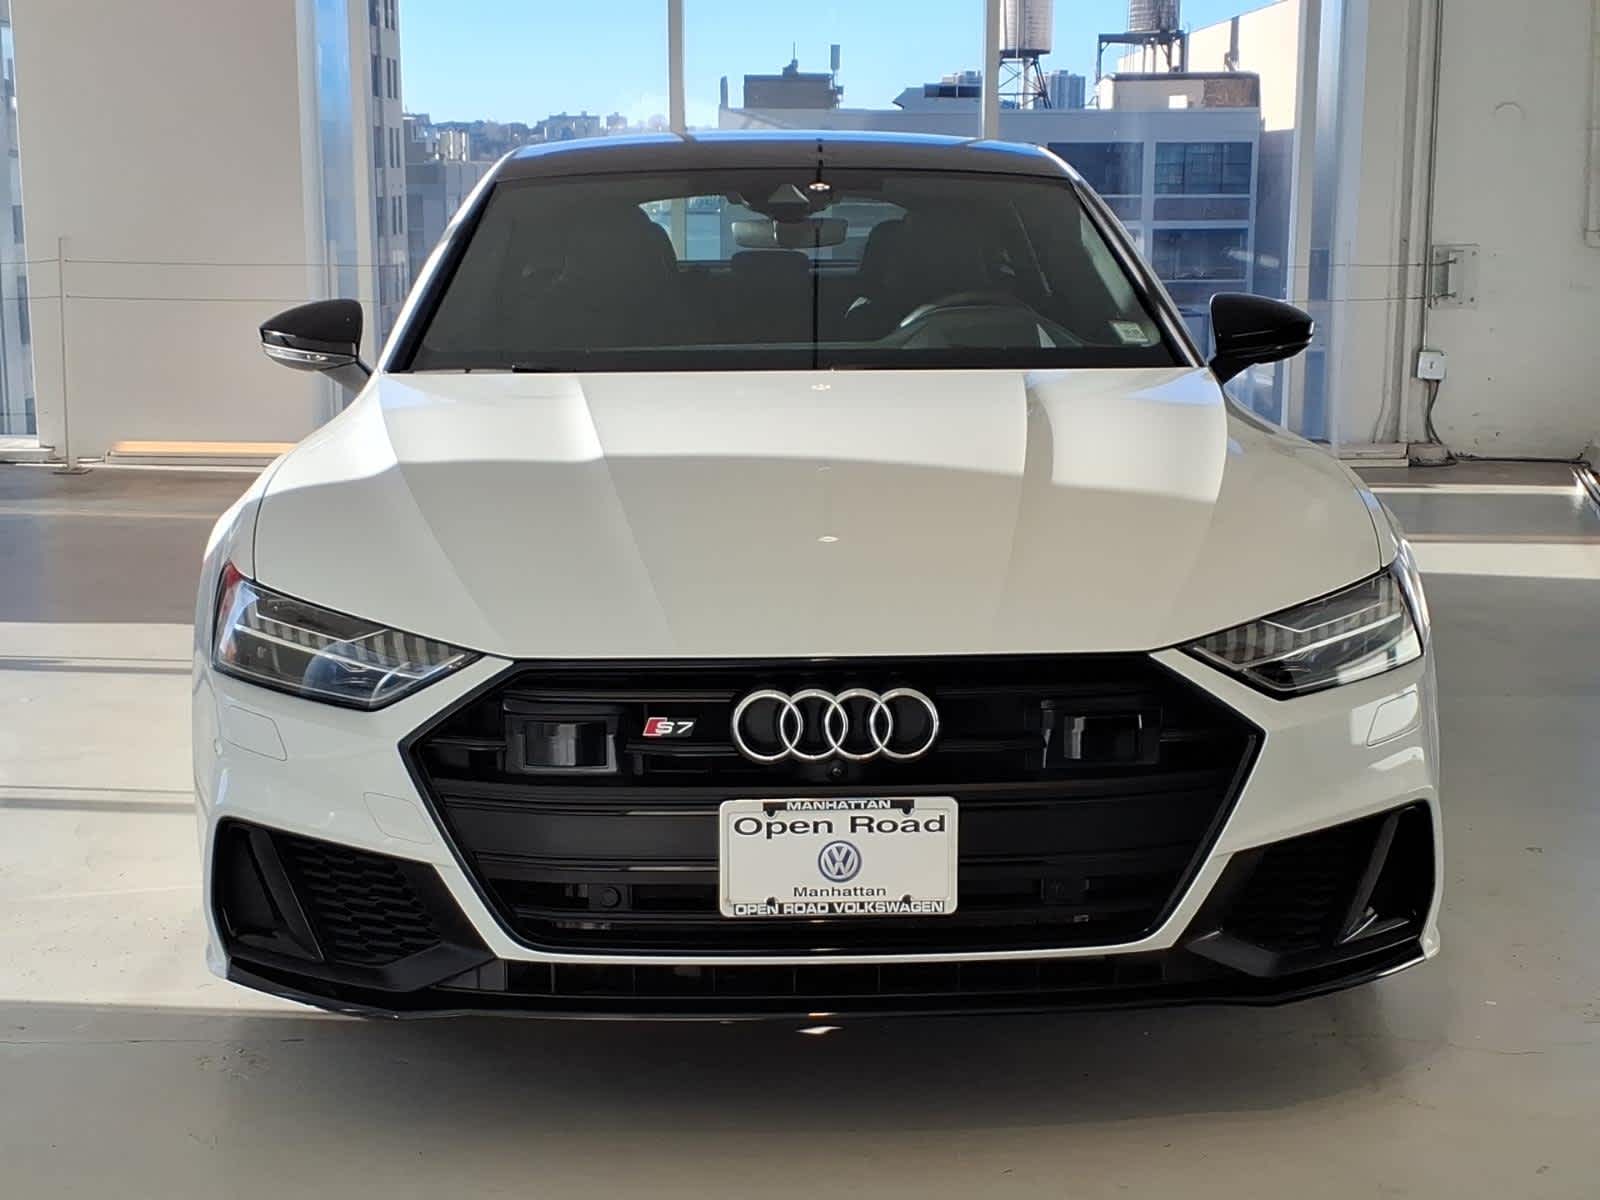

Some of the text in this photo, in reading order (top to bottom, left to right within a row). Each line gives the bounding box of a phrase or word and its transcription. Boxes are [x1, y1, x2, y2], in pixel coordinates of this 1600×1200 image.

[655, 721, 694, 734] S7
[786, 799, 891, 811] MANHATTAN
[733, 814, 946, 840] Open Road
[821, 843, 859, 879] VW
[793, 886, 887, 897] Manhattan
[735, 901, 944, 915] OPEN ROAD VOLKSWAGEN
